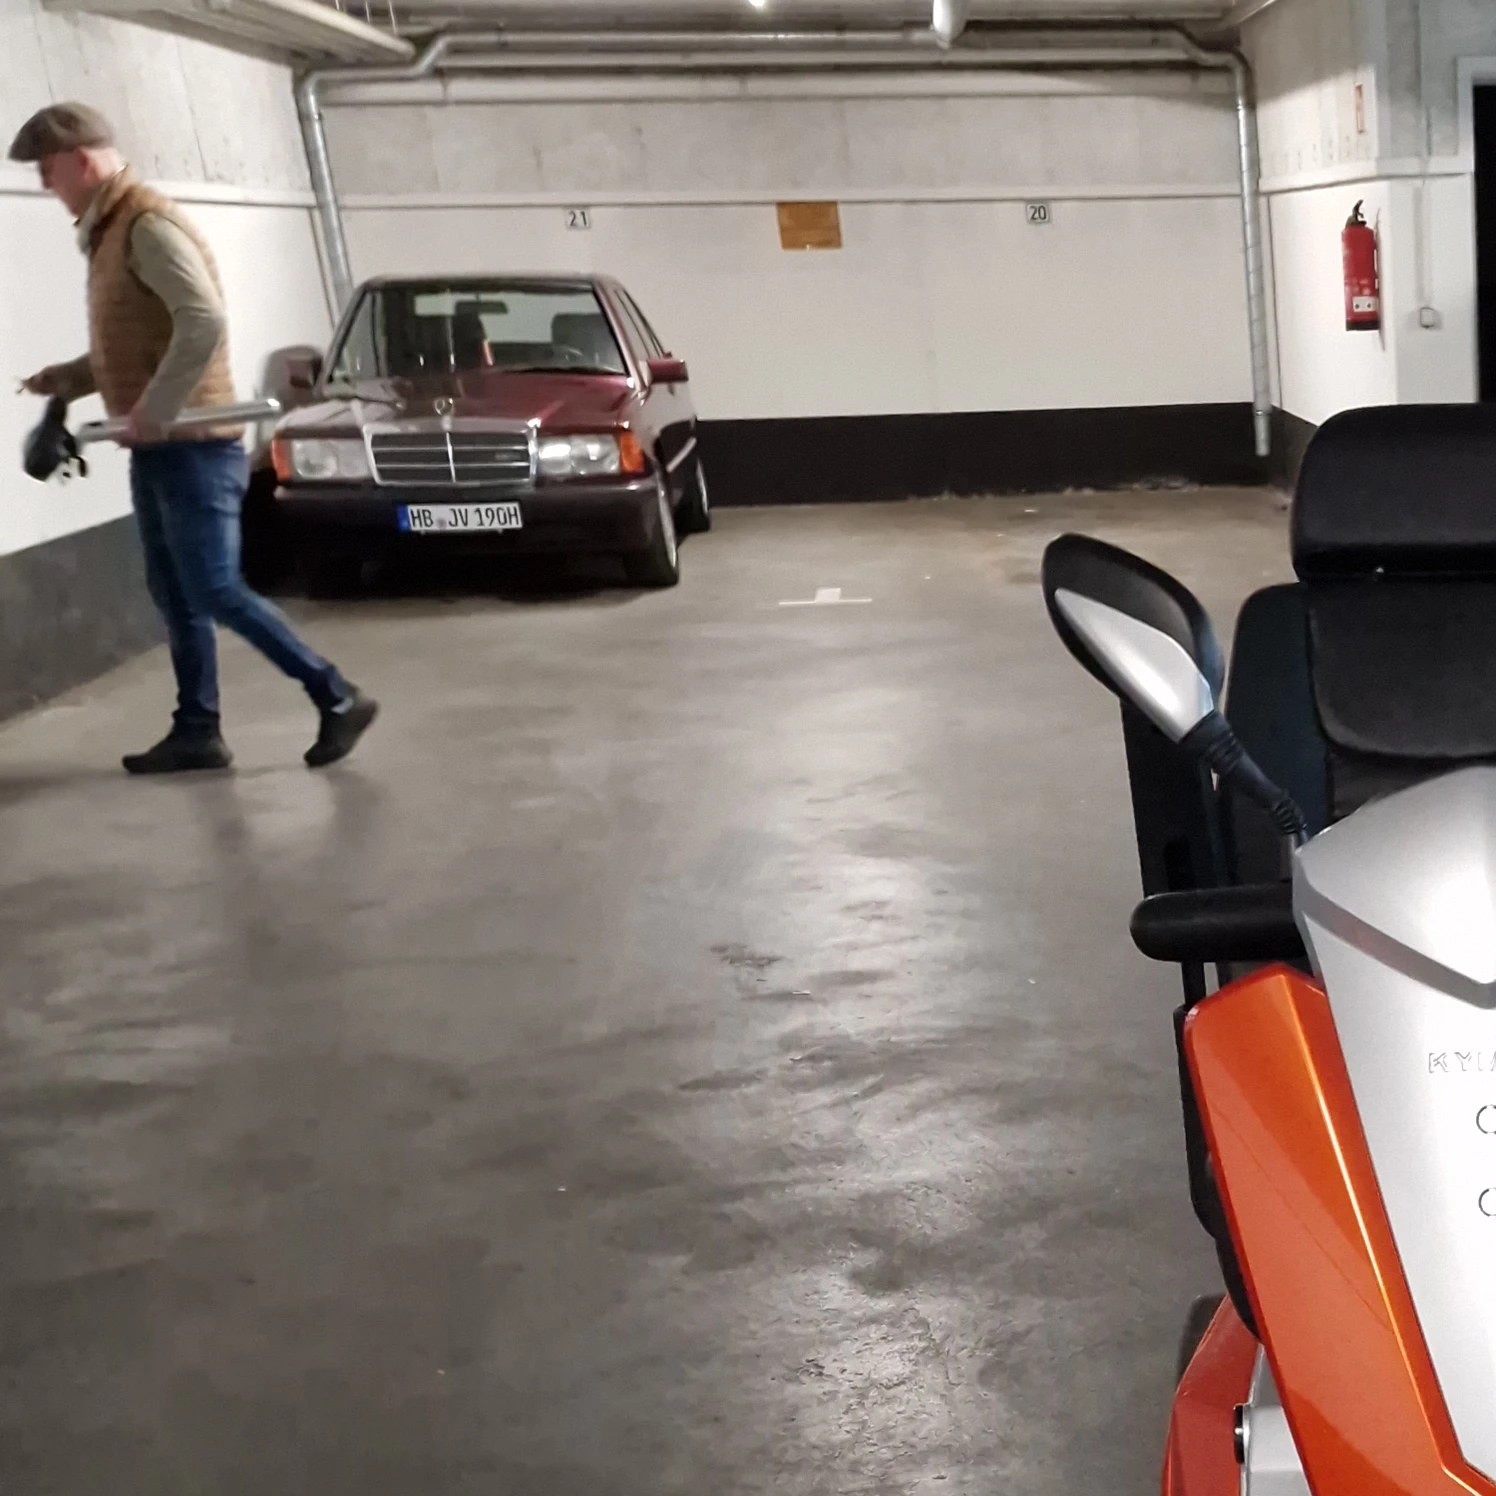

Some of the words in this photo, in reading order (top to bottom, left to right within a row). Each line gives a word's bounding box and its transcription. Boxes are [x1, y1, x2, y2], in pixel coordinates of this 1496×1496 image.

[569, 211, 587, 227] 21
[1029, 205, 1047, 221] 20
[409, 508, 434, 528] HB
[448, 508, 469, 527] JV
[474, 506, 519, 527] 190H
